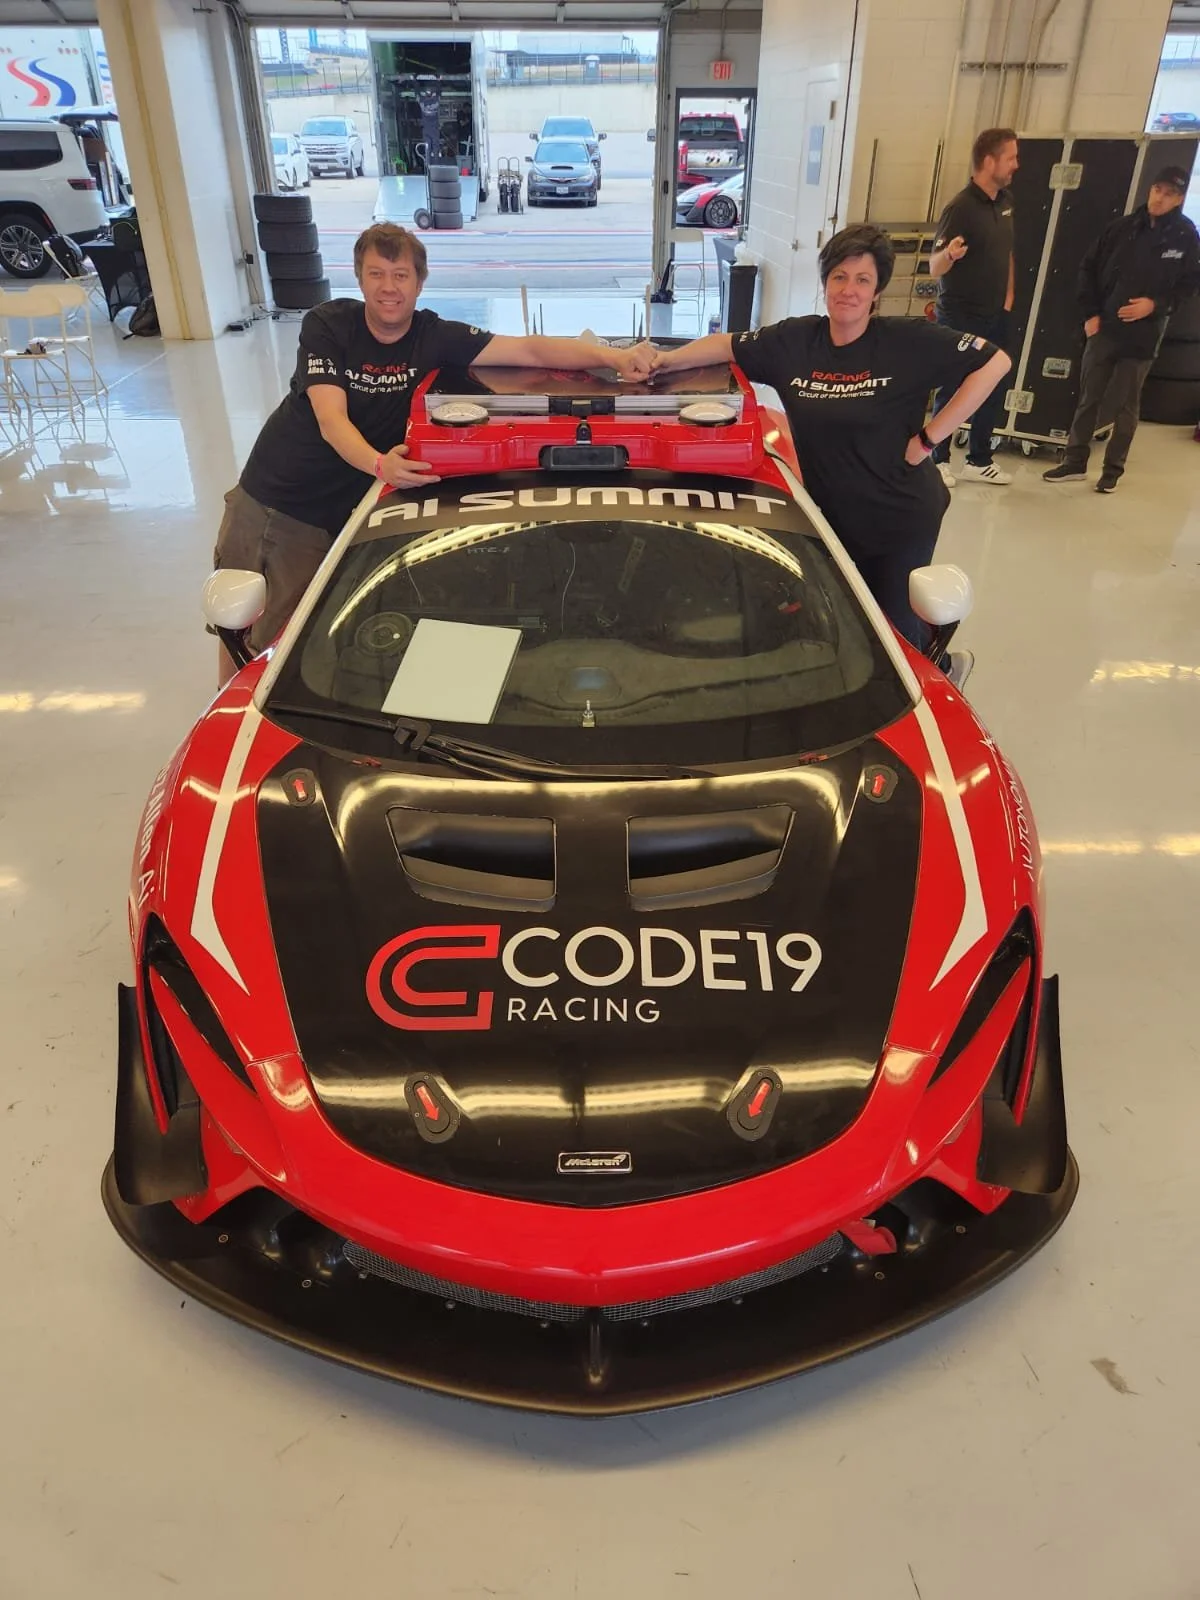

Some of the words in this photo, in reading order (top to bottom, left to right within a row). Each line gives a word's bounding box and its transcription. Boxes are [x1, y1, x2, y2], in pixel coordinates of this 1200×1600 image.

[713, 63, 732, 80] EXIT
[811, 370, 871, 381] RACING
[790, 377, 809, 388] AI
[809, 377, 892, 392] SUMMIT
[798, 390, 819, 398] Circuit
[368, 498, 438, 528] AI
[459, 487, 787, 514] SUMMIT
[502, 926, 823, 992] CODE19
[507, 997, 660, 1023] RACING
[564, 1158, 621, 1167] McLaren
